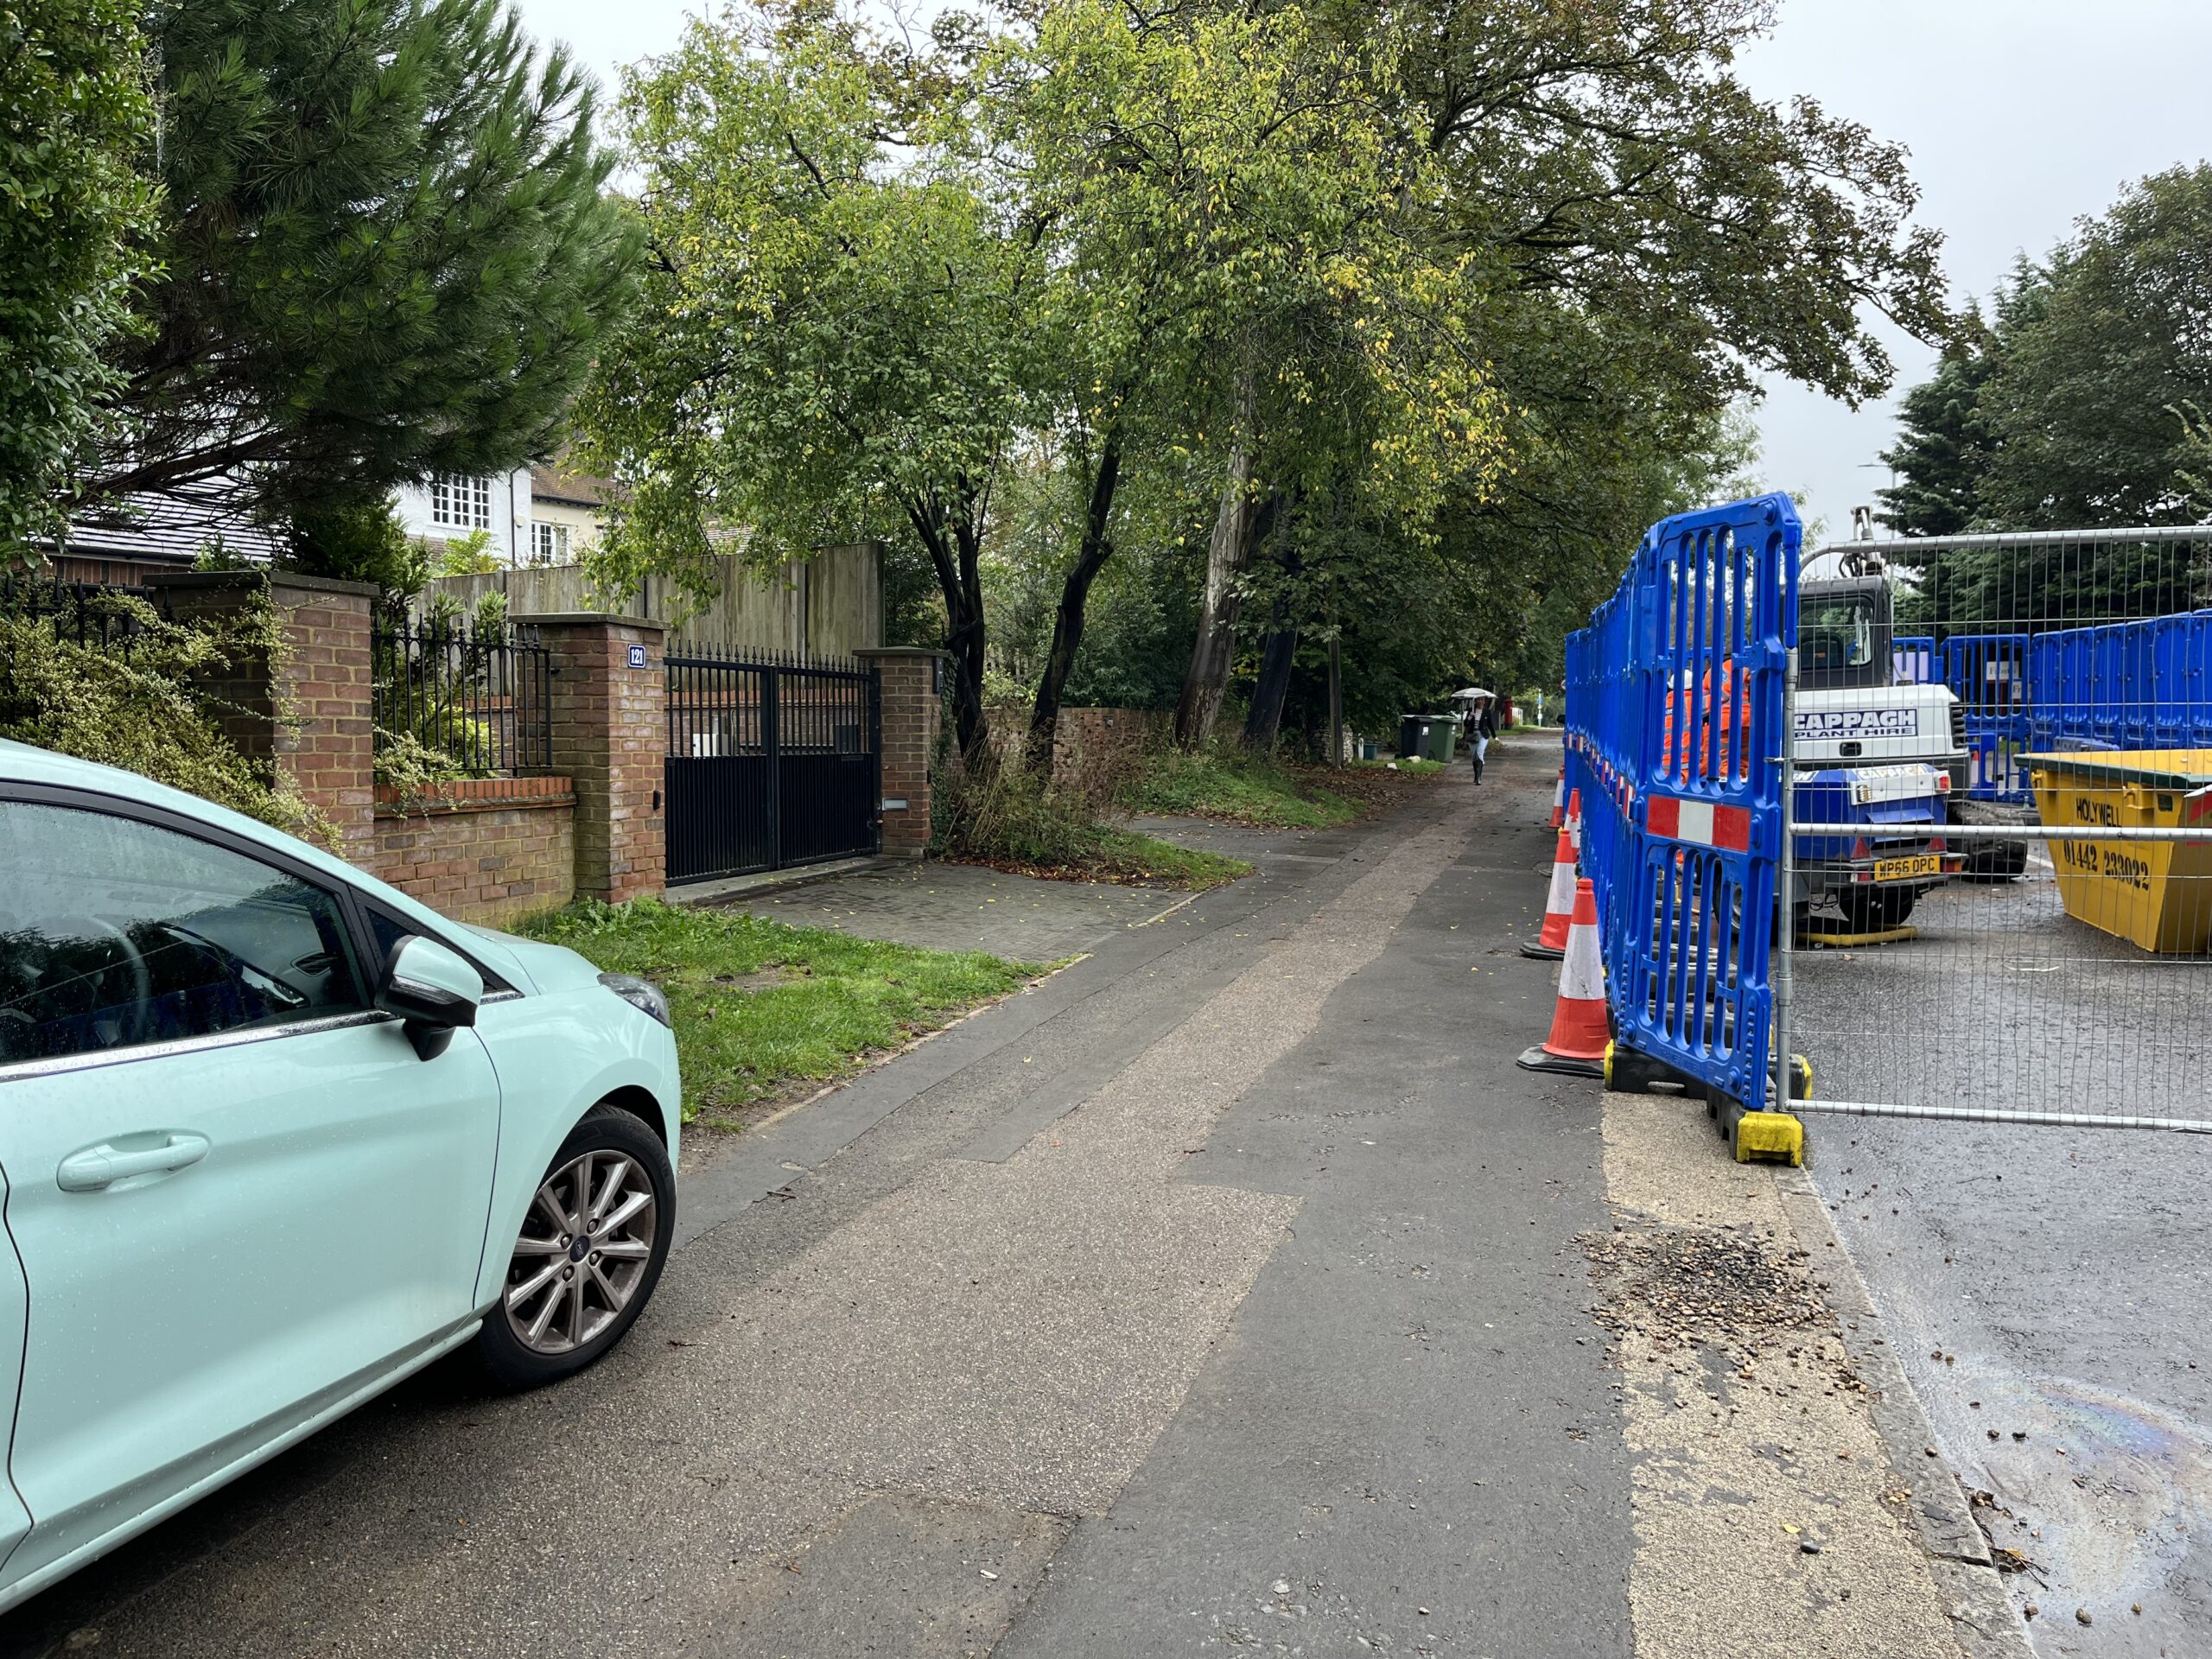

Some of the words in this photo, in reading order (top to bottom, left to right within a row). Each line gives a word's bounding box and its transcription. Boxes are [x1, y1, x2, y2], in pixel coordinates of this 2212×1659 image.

[630, 648, 643, 664] 121
[1795, 709, 1916, 731] CAPPAGH
[1795, 729, 1855, 739] PLANT
[1865, 727, 1913, 735] HIRE
[2075, 798, 2122, 827] HOLYWELL
[2063, 840, 2098, 872] 01442
[2104, 850, 2149, 891] 233022
